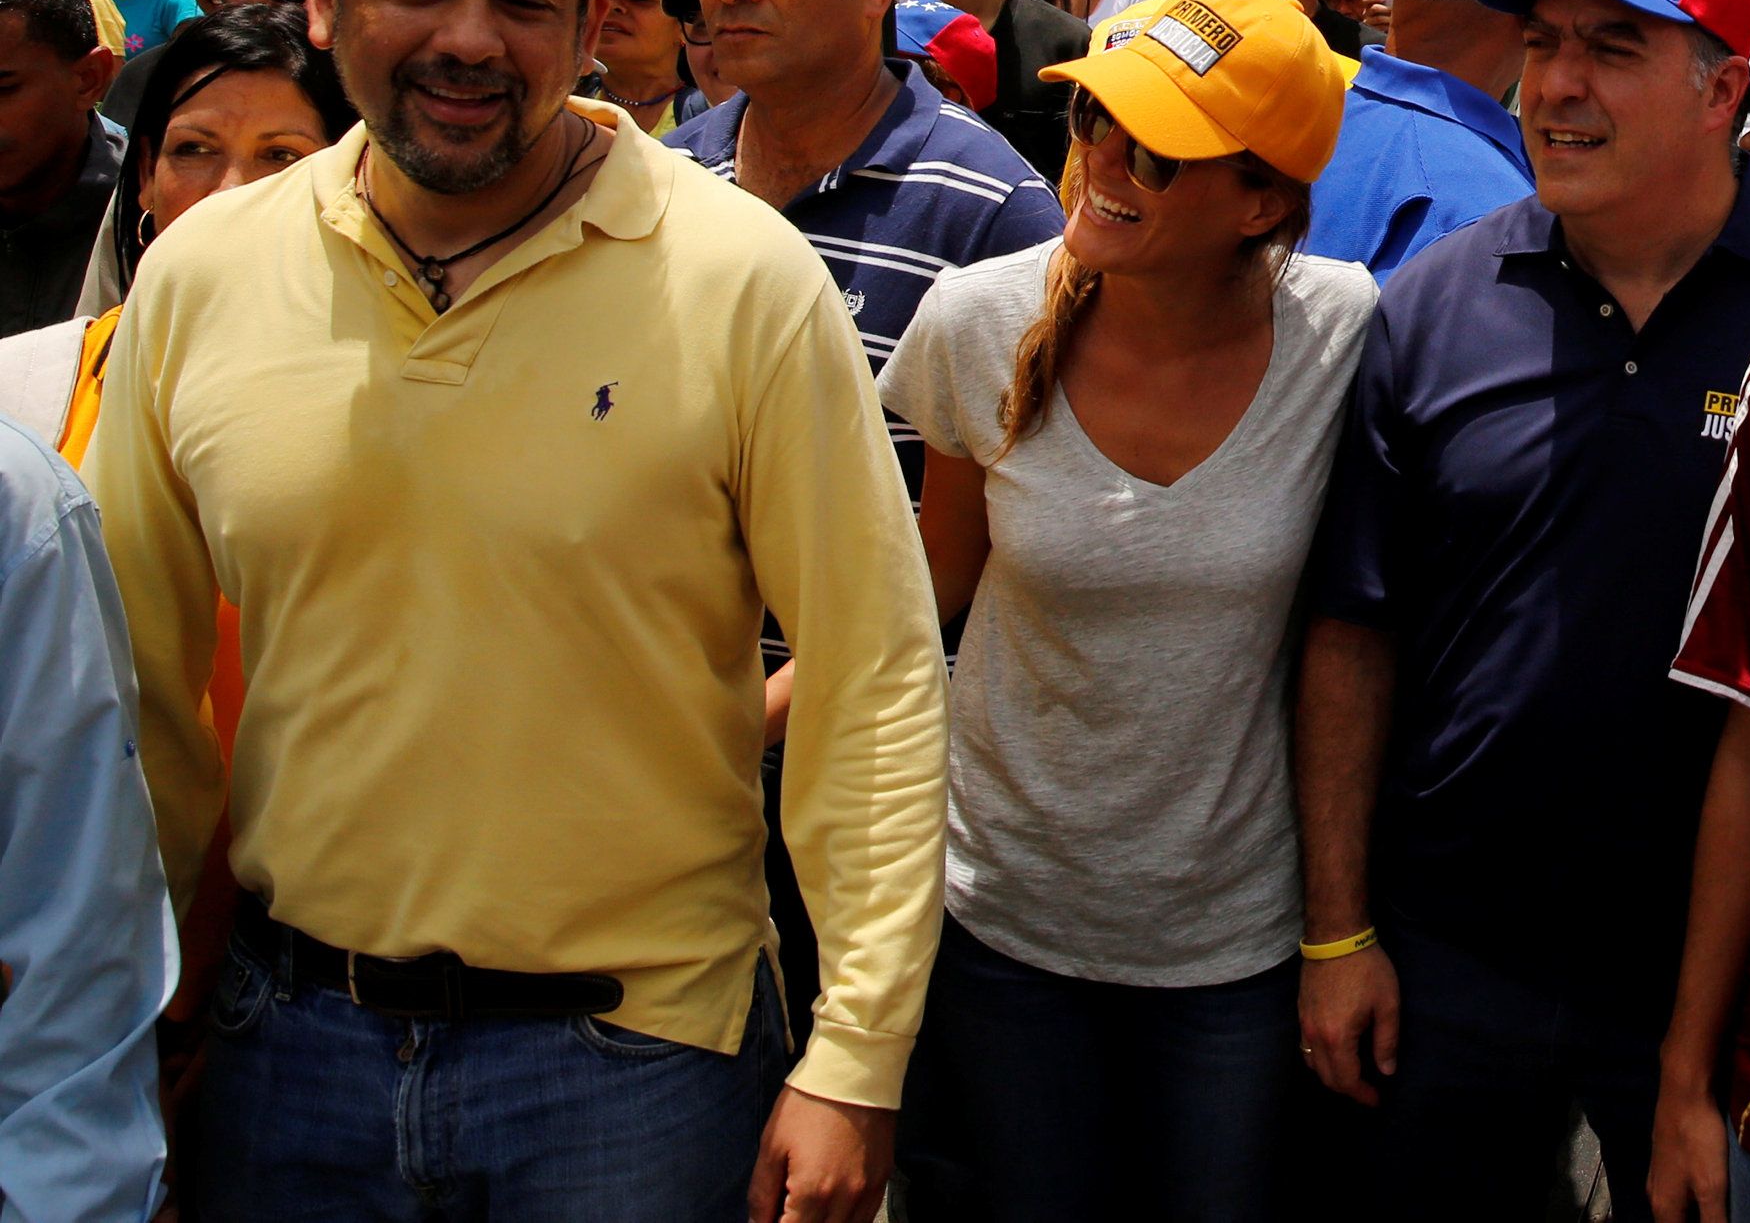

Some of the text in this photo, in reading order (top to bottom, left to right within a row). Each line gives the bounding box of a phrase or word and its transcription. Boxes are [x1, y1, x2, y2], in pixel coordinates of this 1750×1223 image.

[1176, 0, 1237, 50] PRIMERO
[1707, 393, 1739, 414] PRI
[1701, 413, 1735, 442] JUS
